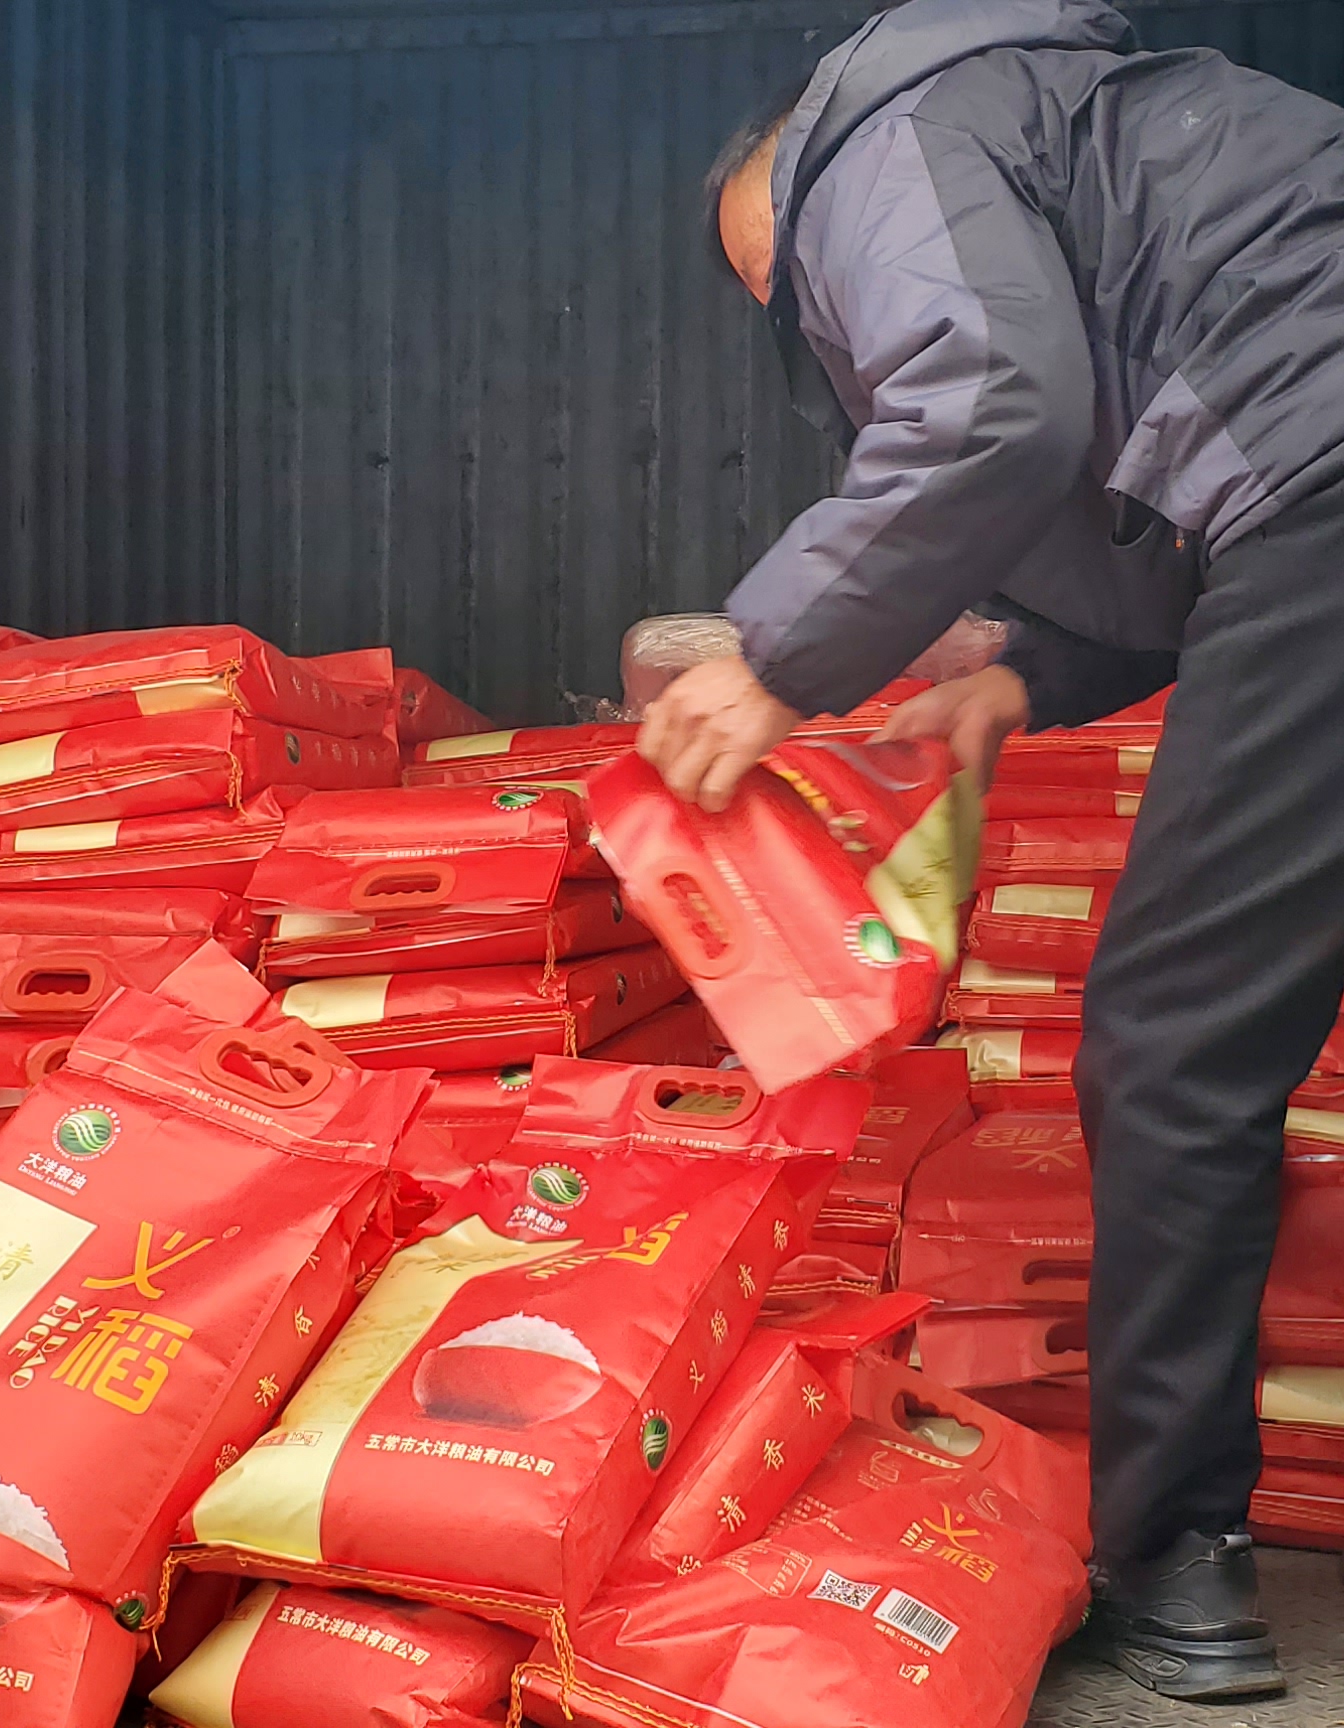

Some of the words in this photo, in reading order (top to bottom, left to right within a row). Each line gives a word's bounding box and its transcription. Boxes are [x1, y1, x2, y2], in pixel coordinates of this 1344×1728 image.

[23, 1152, 87, 1190] 大洋粮油
[509, 1204, 568, 1234] 大洋粮油
[8, 1295, 78, 1358] RICE
[50, 1221, 215, 1414] 义稻
[364, 1433, 556, 1477] 五常市大洋粮油有限公司
[277, 1605, 431, 1667] 五常市大洋粮油有限公司
